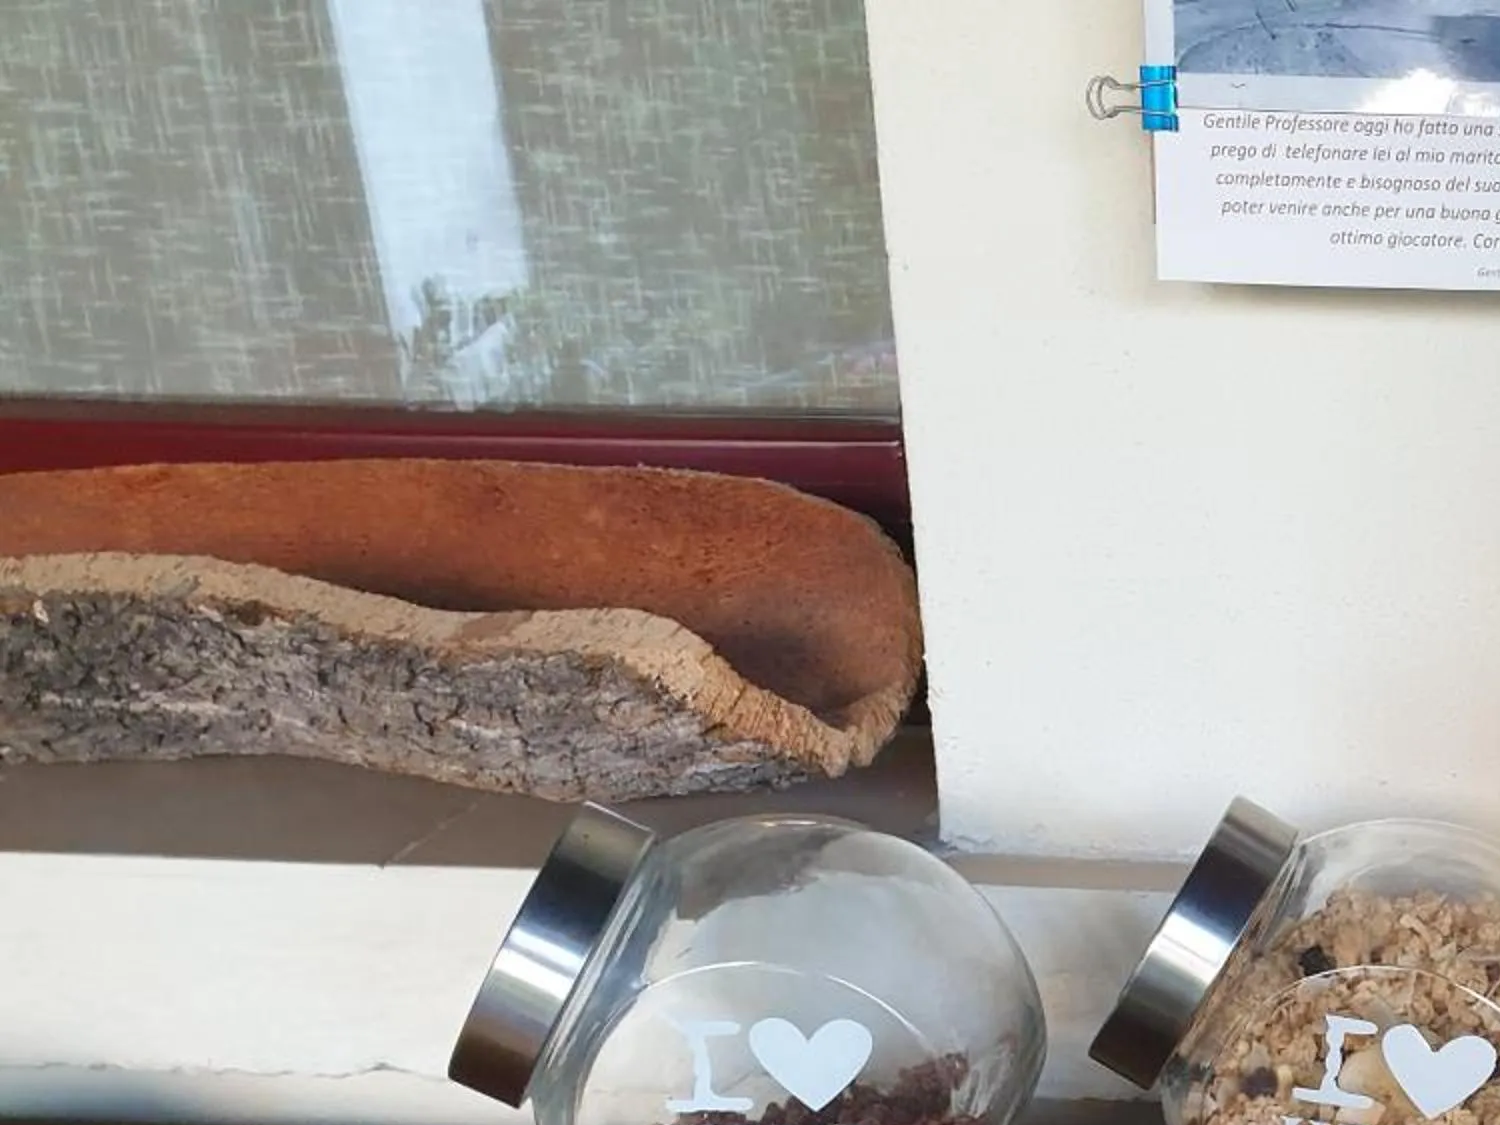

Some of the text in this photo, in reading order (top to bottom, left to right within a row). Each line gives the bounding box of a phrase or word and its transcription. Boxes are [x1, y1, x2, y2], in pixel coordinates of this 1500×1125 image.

[1203, 113, 1261, 129] Gentile
[1265, 115, 1349, 134] Professore
[1353, 118, 1390, 137] oggi
[1393, 118, 1414, 134] ho
[1417, 119, 1459, 138] fatto
[1463, 124, 1494, 137] una
[1210, 144, 1257, 161] prego
[1261, 143, 1277, 158] di
[1285, 144, 1369, 163] telefonare
[1372, 146, 1391, 161] lei
[1395, 147, 1411, 163] al
[1415, 149, 1445, 163] mio
[1215, 170, 1343, 189] completamente
[1346, 176, 1357, 189] e
[1361, 173, 1441, 194] bisognoso
[1445, 176, 1471, 193] del
[1221, 199, 1264, 217] poter
[1268, 200, 1318, 217] venire
[1321, 202, 1371, 218] anche
[1374, 206, 1402, 221] per
[1405, 207, 1436, 220] una
[1440, 204, 1491, 221] buona
[1329, 230, 1383, 246] ottimo
[1387, 231, 1467, 250] giocatore.
[1292, 1013, 1379, 1110] I
